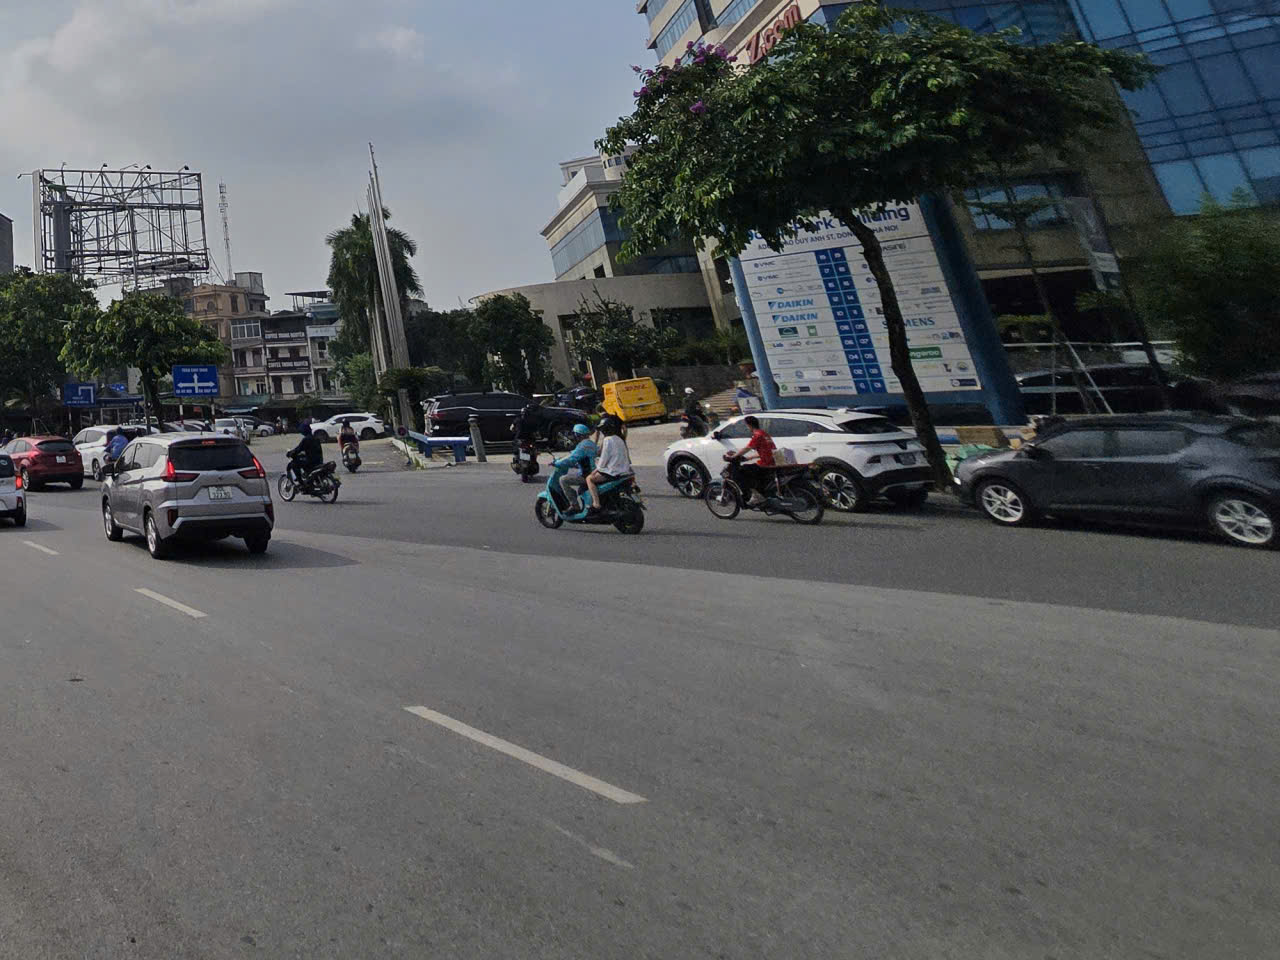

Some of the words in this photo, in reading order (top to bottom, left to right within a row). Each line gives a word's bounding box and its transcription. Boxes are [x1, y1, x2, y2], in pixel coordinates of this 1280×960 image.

[745, 5, 801, 65] Z.com
[777, 299, 814, 309] DAIKIN
[781, 313, 818, 323] DAIKIN
